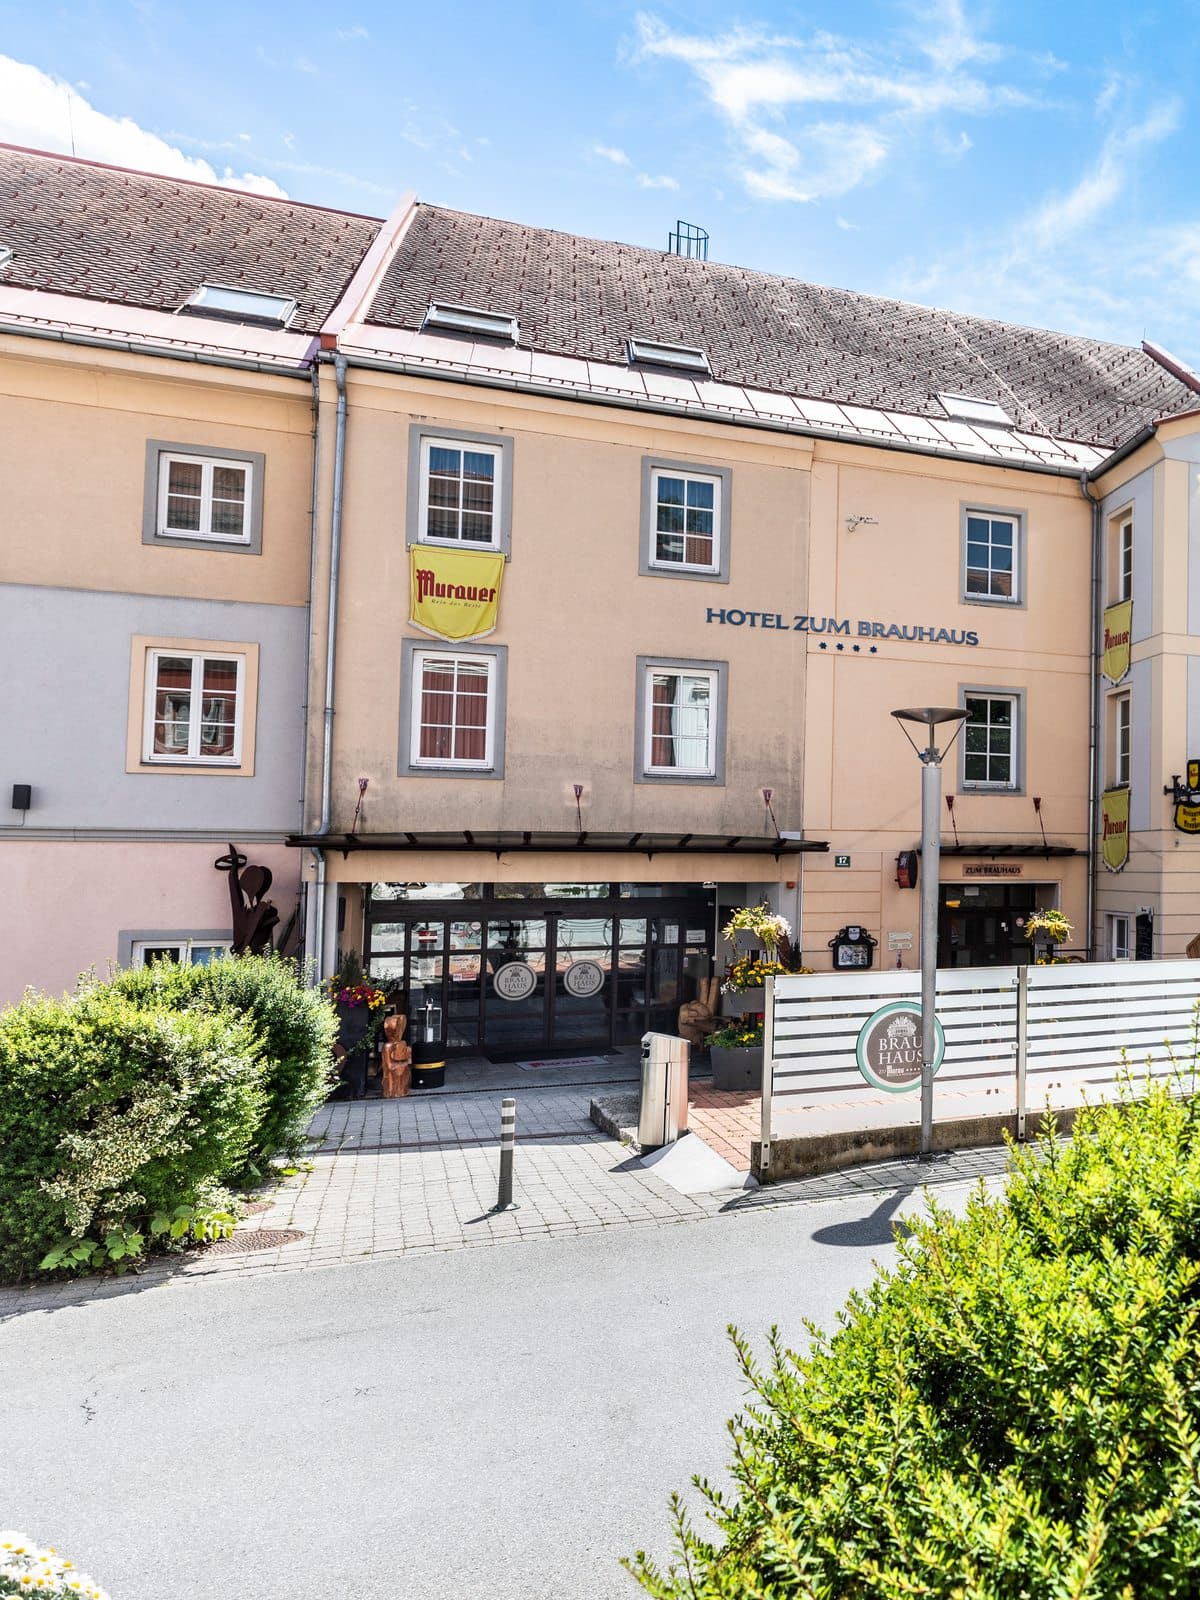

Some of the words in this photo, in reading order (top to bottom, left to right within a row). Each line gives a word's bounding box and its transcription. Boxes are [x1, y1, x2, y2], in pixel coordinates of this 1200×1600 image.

[416, 568, 497, 604] Murauer
[705, 607, 789, 631] HOTEL
[793, 615, 851, 635] ZUM
[857, 620, 980, 646] BRAUHAUS
[838, 856, 848, 865] 17
[965, 866, 982, 874] ZUM
[983, 866, 1021, 875] BRAUHAUS
[878, 1036, 923, 1051] BRAU
[878, 1049, 922, 1065] HAUS
